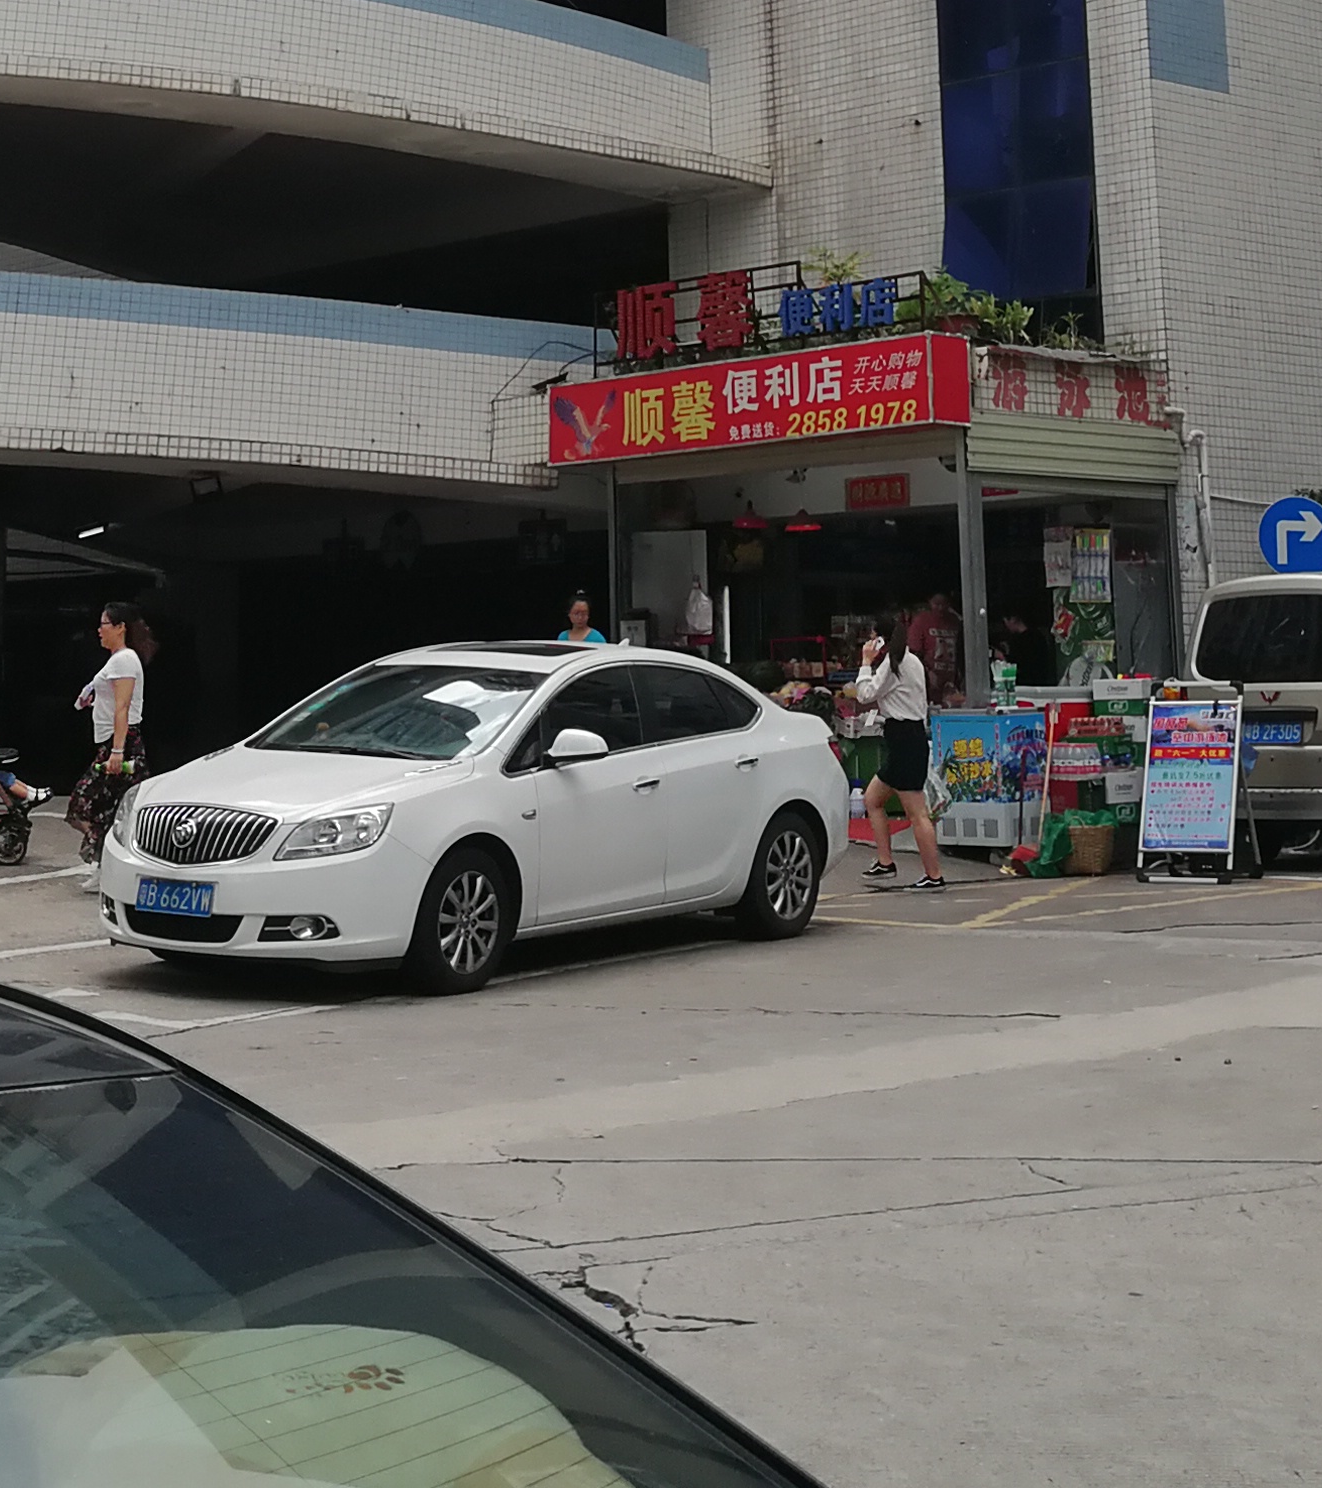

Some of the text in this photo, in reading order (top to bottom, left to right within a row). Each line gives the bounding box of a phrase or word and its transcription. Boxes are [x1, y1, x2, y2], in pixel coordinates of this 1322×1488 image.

[617, 270, 896, 358] 顺馨 便利店
[853, 350, 923, 375] 开心购物
[622, 356, 843, 447] 顺馨 便利店
[848, 370, 918, 396] 天天顺馨
[786, 408, 848, 438] 2858
[855, 398, 918, 429] 1978
